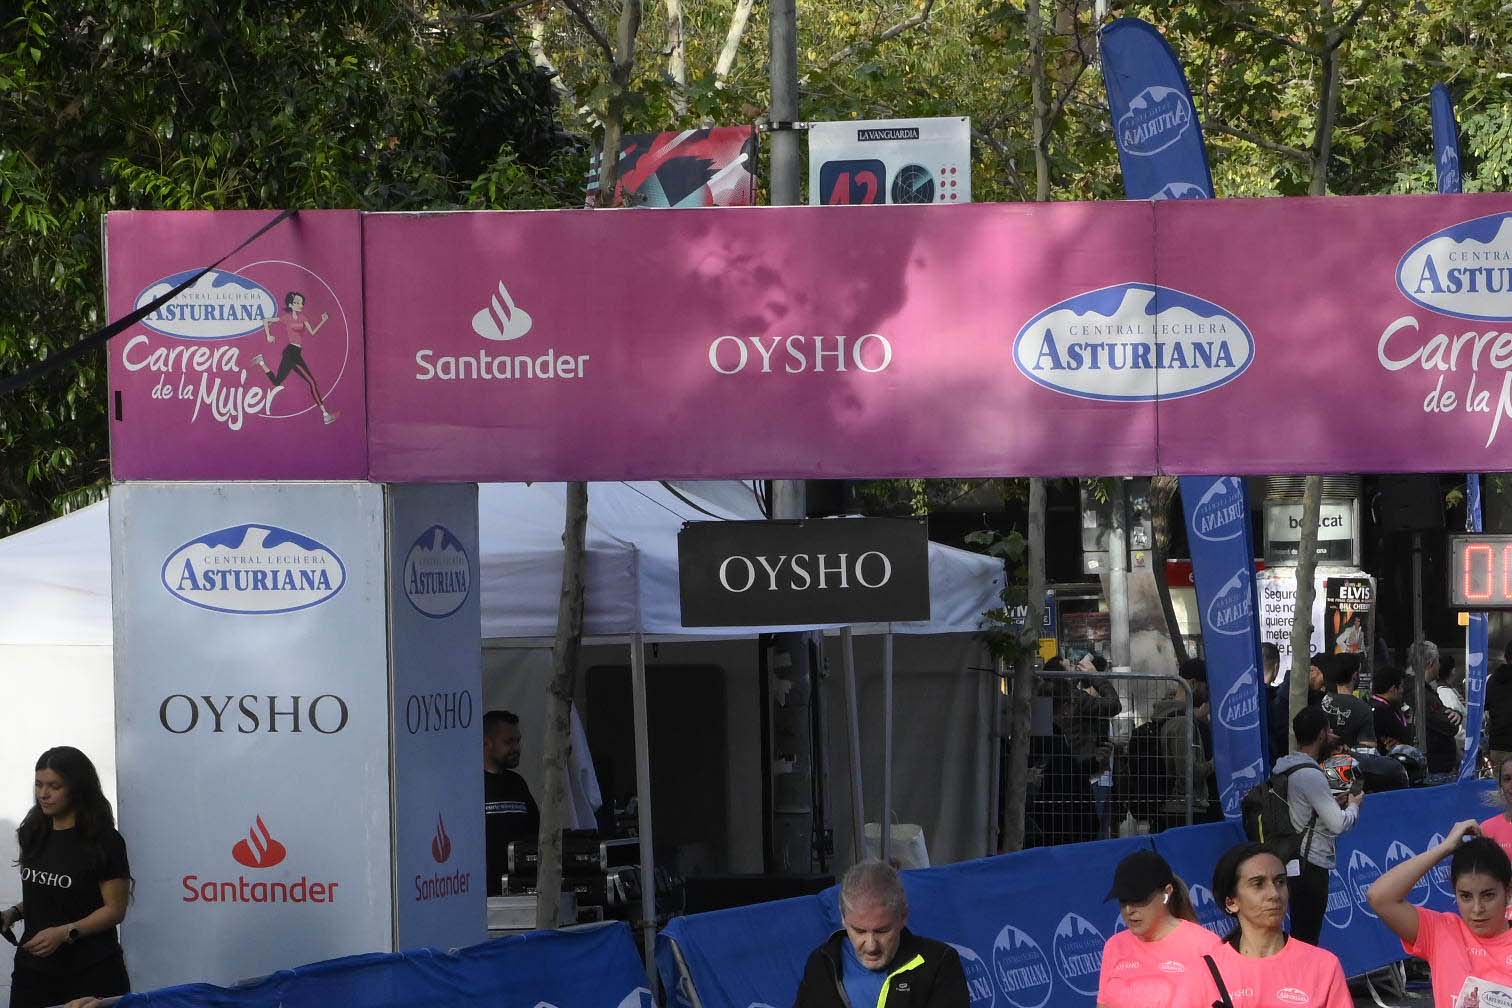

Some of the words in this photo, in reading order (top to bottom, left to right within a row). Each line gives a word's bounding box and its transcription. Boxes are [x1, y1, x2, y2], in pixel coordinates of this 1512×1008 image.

[868, 129, 919, 140] VANGUARDIA
[145, 295, 266, 321] ASTURIANA
[1068, 323, 1145, 336] CENTRAL
[1151, 322, 1228, 336] LECHERA
[122, 335, 241, 372] Carrera
[415, 349, 590, 381] Santander
[708, 333, 894, 374] OYSHO
[1031, 327, 1237, 372] ASTURIANA
[152, 375, 174, 400] de
[178, 373, 194, 400] la
[191, 369, 285, 431] Mujer
[1424, 374, 1458, 413] de
[1465, 373, 1490, 413] la
[175, 558, 333, 593] ASTURIANA
[204, 556, 263, 565] CENTRAL
[267, 555, 326, 565] LECHERA
[719, 551, 892, 593] OYSHO
[409, 564, 467, 596] ASTURIANA
[1339, 586, 1370, 599] ELVIS
[1265, 602, 1281, 615] que
[160, 694, 349, 734] OYSHO
[406, 689, 472, 735] OYSHO
[21, 868, 72, 890] OYSHO
[182, 875, 340, 905] Santander
[414, 871, 472, 902] Santander
